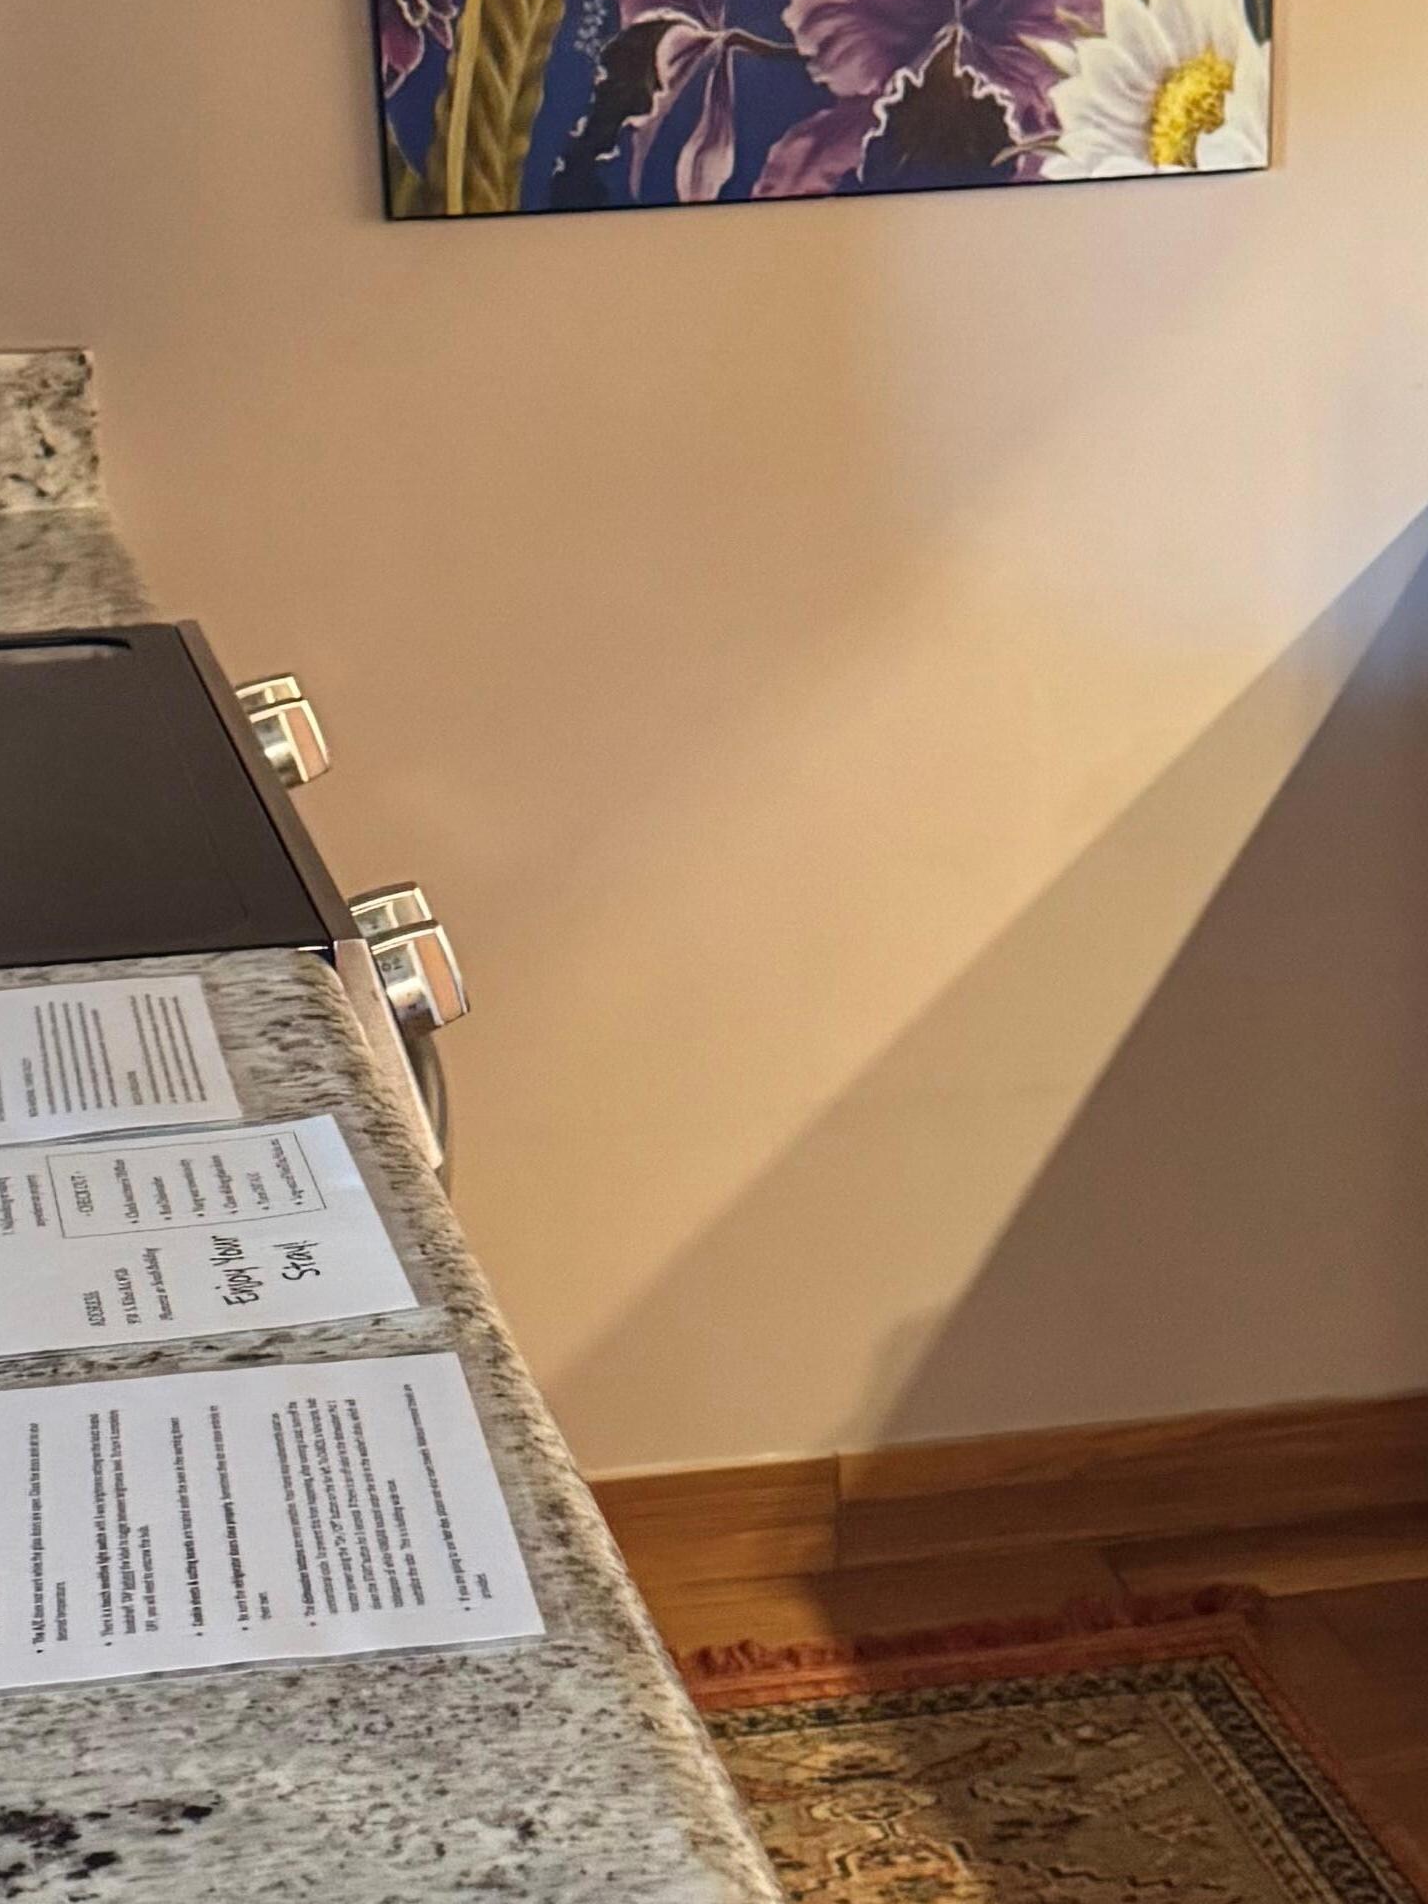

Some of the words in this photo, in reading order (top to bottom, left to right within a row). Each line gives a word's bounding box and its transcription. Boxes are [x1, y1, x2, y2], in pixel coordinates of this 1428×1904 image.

[209, 1235, 244, 1266] Your
[273, 1240, 320, 1280] Stay!
[214, 1266, 263, 1305] Enjoy
